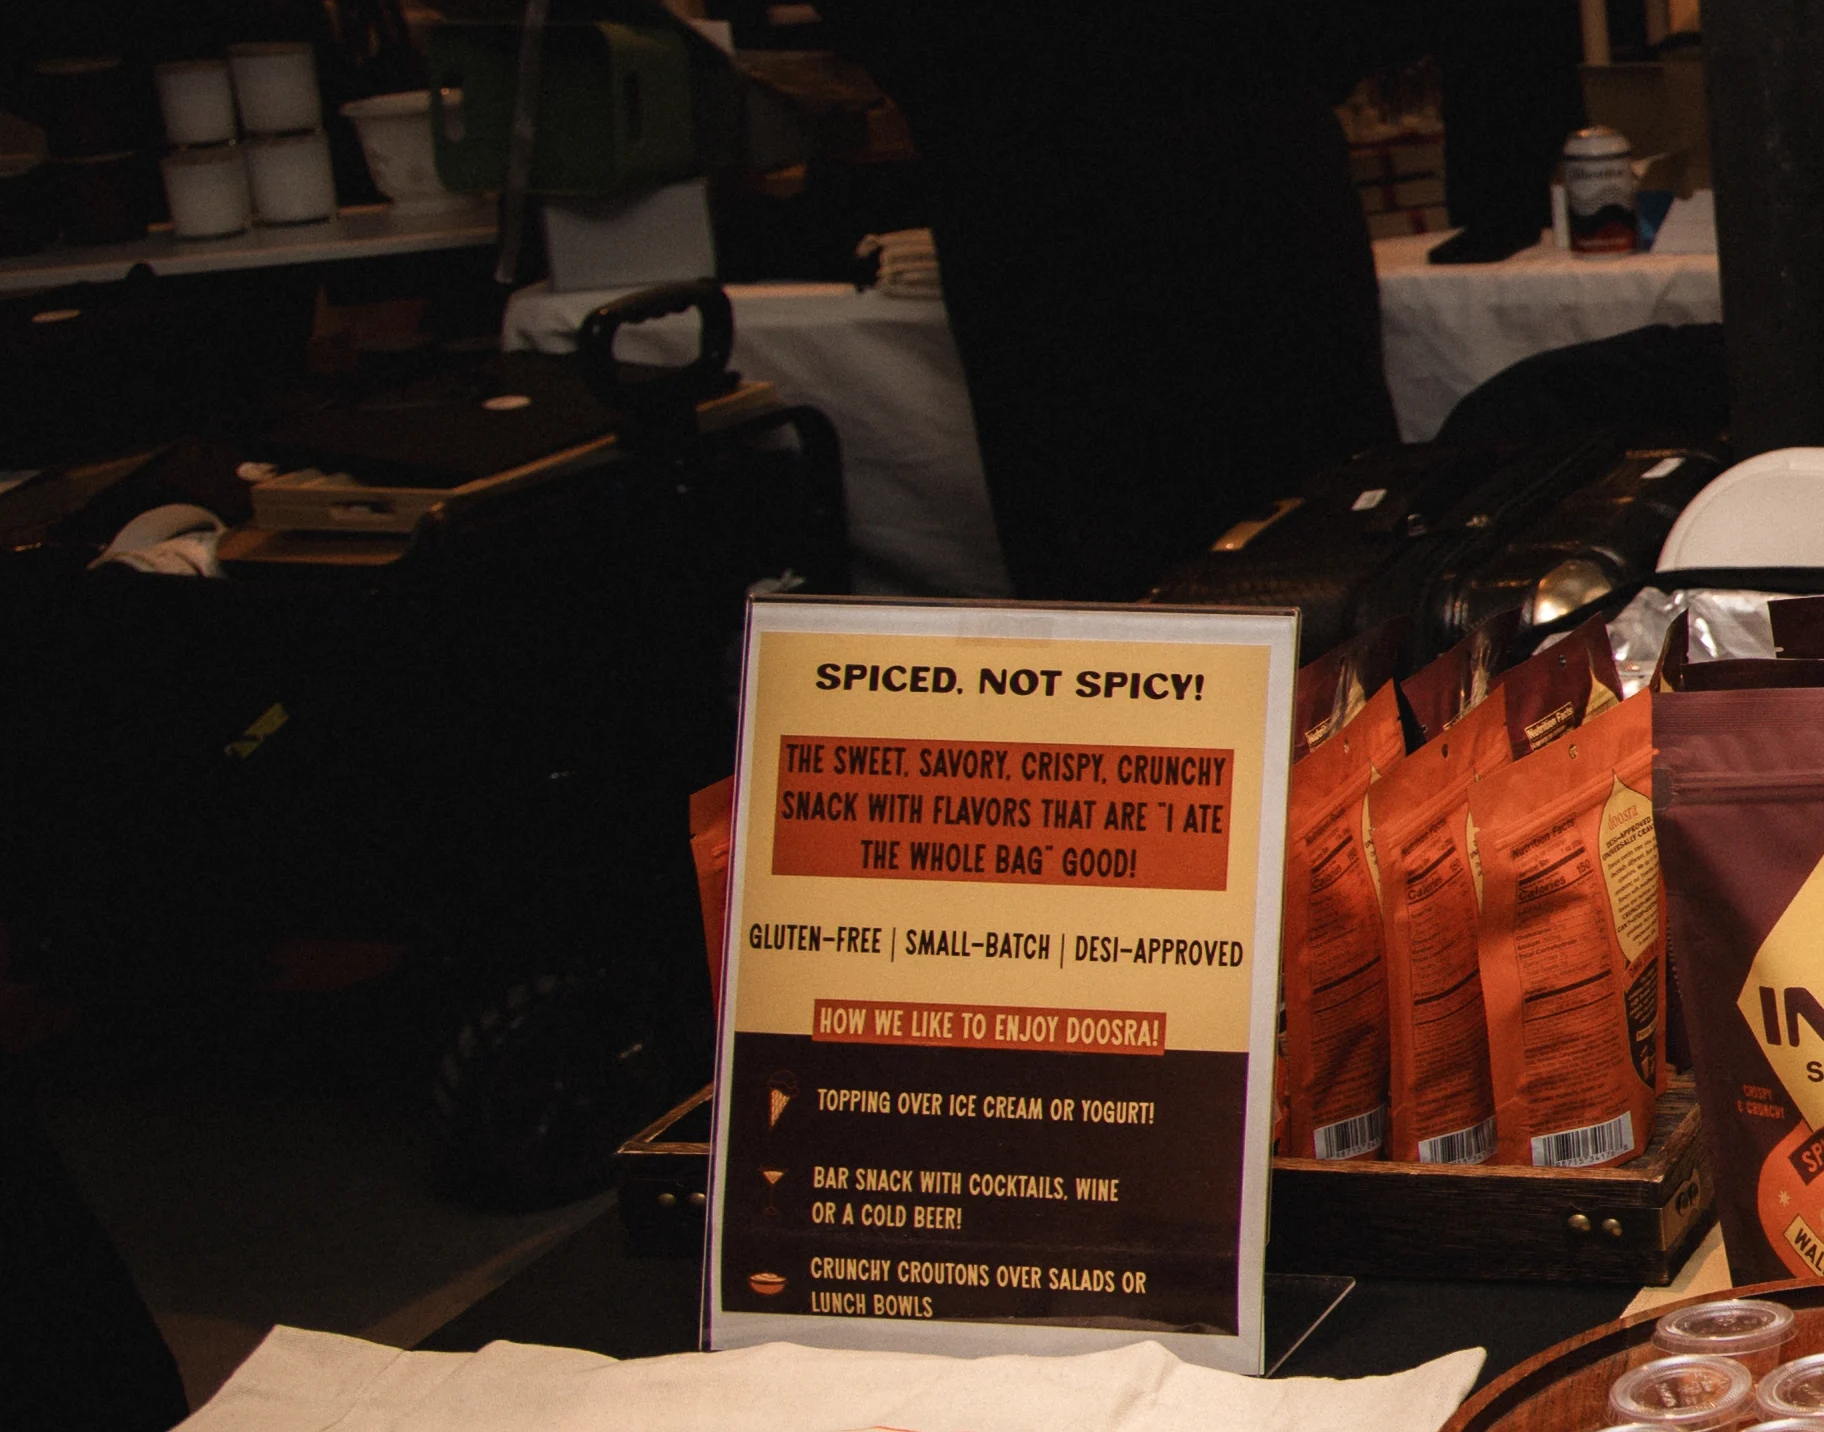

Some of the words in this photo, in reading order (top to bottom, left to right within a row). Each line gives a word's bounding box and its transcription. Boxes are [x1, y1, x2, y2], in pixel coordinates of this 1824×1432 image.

[816, 664, 962, 694] SPICED,
[980, 668, 1062, 696] NOT
[1076, 671, 1204, 701] SPICY!
[786, 744, 825, 773] THE
[834, 746, 908, 777] SWEET,
[920, 748, 1010, 781] SAVORY,
[1022, 752, 1106, 784] CRISPY,
[1118, 755, 1225, 786] CRUNCHY
[781, 791, 858, 821] SNACK
[869, 793, 923, 823] WITH
[933, 796, 1031, 827] FLAVORS
[1042, 799, 1096, 829] THAT
[1104, 802, 1147, 831] ARE
[1158, 802, 1173, 832] "I
[1183, 804, 1223, 833] ATE
[861, 840, 900, 870] THE
[910, 842, 986, 873] WHOLE
[996, 845, 1053, 875] BAG"
[1063, 848, 1136, 878] GOOD!
[749, 923, 882, 953] GLUTEN-FREE
[906, 929, 1050, 959] SMALL-BATCH
[1076, 936, 1243, 966] DESI-APPROVED
[821, 1008, 866, 1034] HOW
[875, 1010, 903, 1036] WE
[912, 1011, 953, 1038] LIKE
[962, 1013, 986, 1039] TO
[995, 1014, 1058, 1042] ENJOY
[1067, 1017, 1158, 1046] DOOSRA!
[818, 1089, 890, 1113] TOPPING
[898, 1093, 942, 1115] OVER
[950, 1095, 976, 1116] ICE
[984, 1096, 1042, 1119] CREAM
[1051, 1099, 1074, 1121] OR
[1082, 1100, 1154, 1124] YOGURT!
